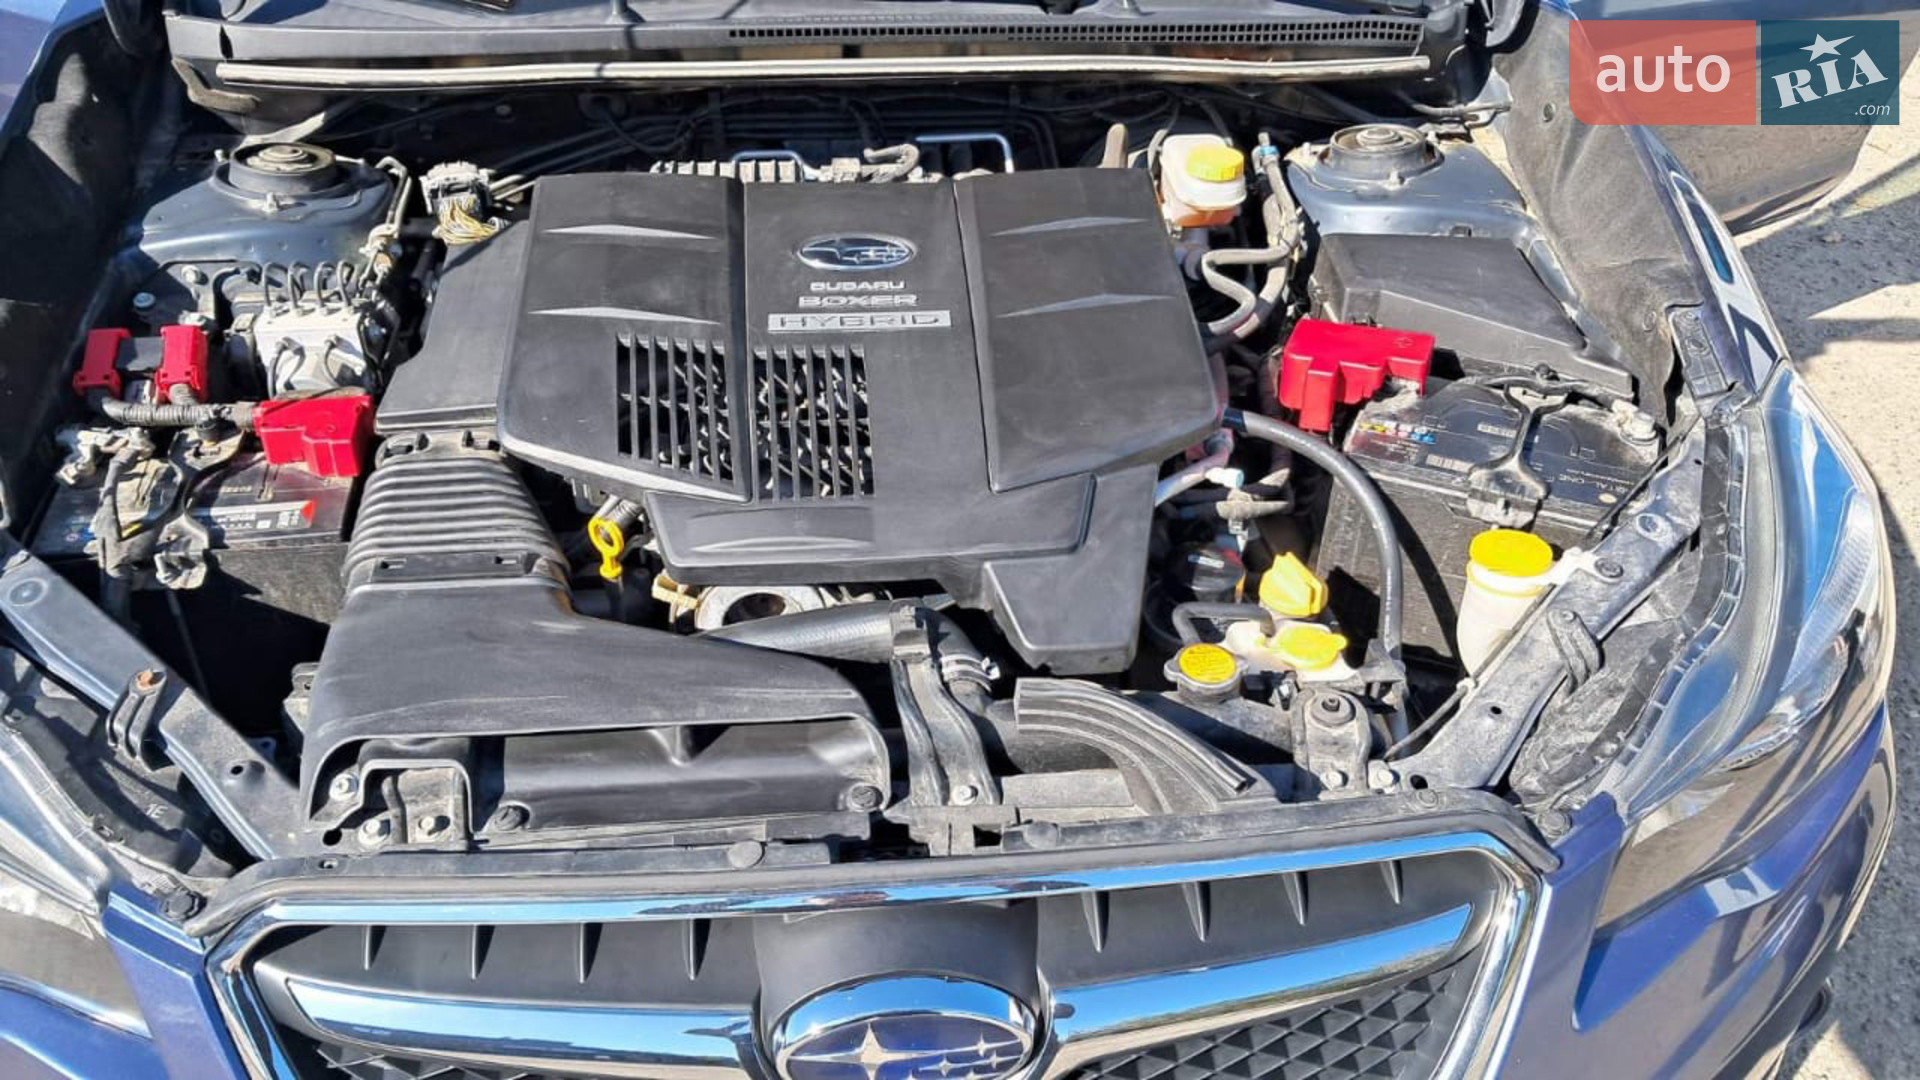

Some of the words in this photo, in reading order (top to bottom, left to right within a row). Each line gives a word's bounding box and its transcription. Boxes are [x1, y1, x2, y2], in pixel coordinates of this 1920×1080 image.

[810, 280, 905, 292] SUBARU
[799, 294, 918, 308] BOXER
[780, 314, 940, 327] HYBRID
